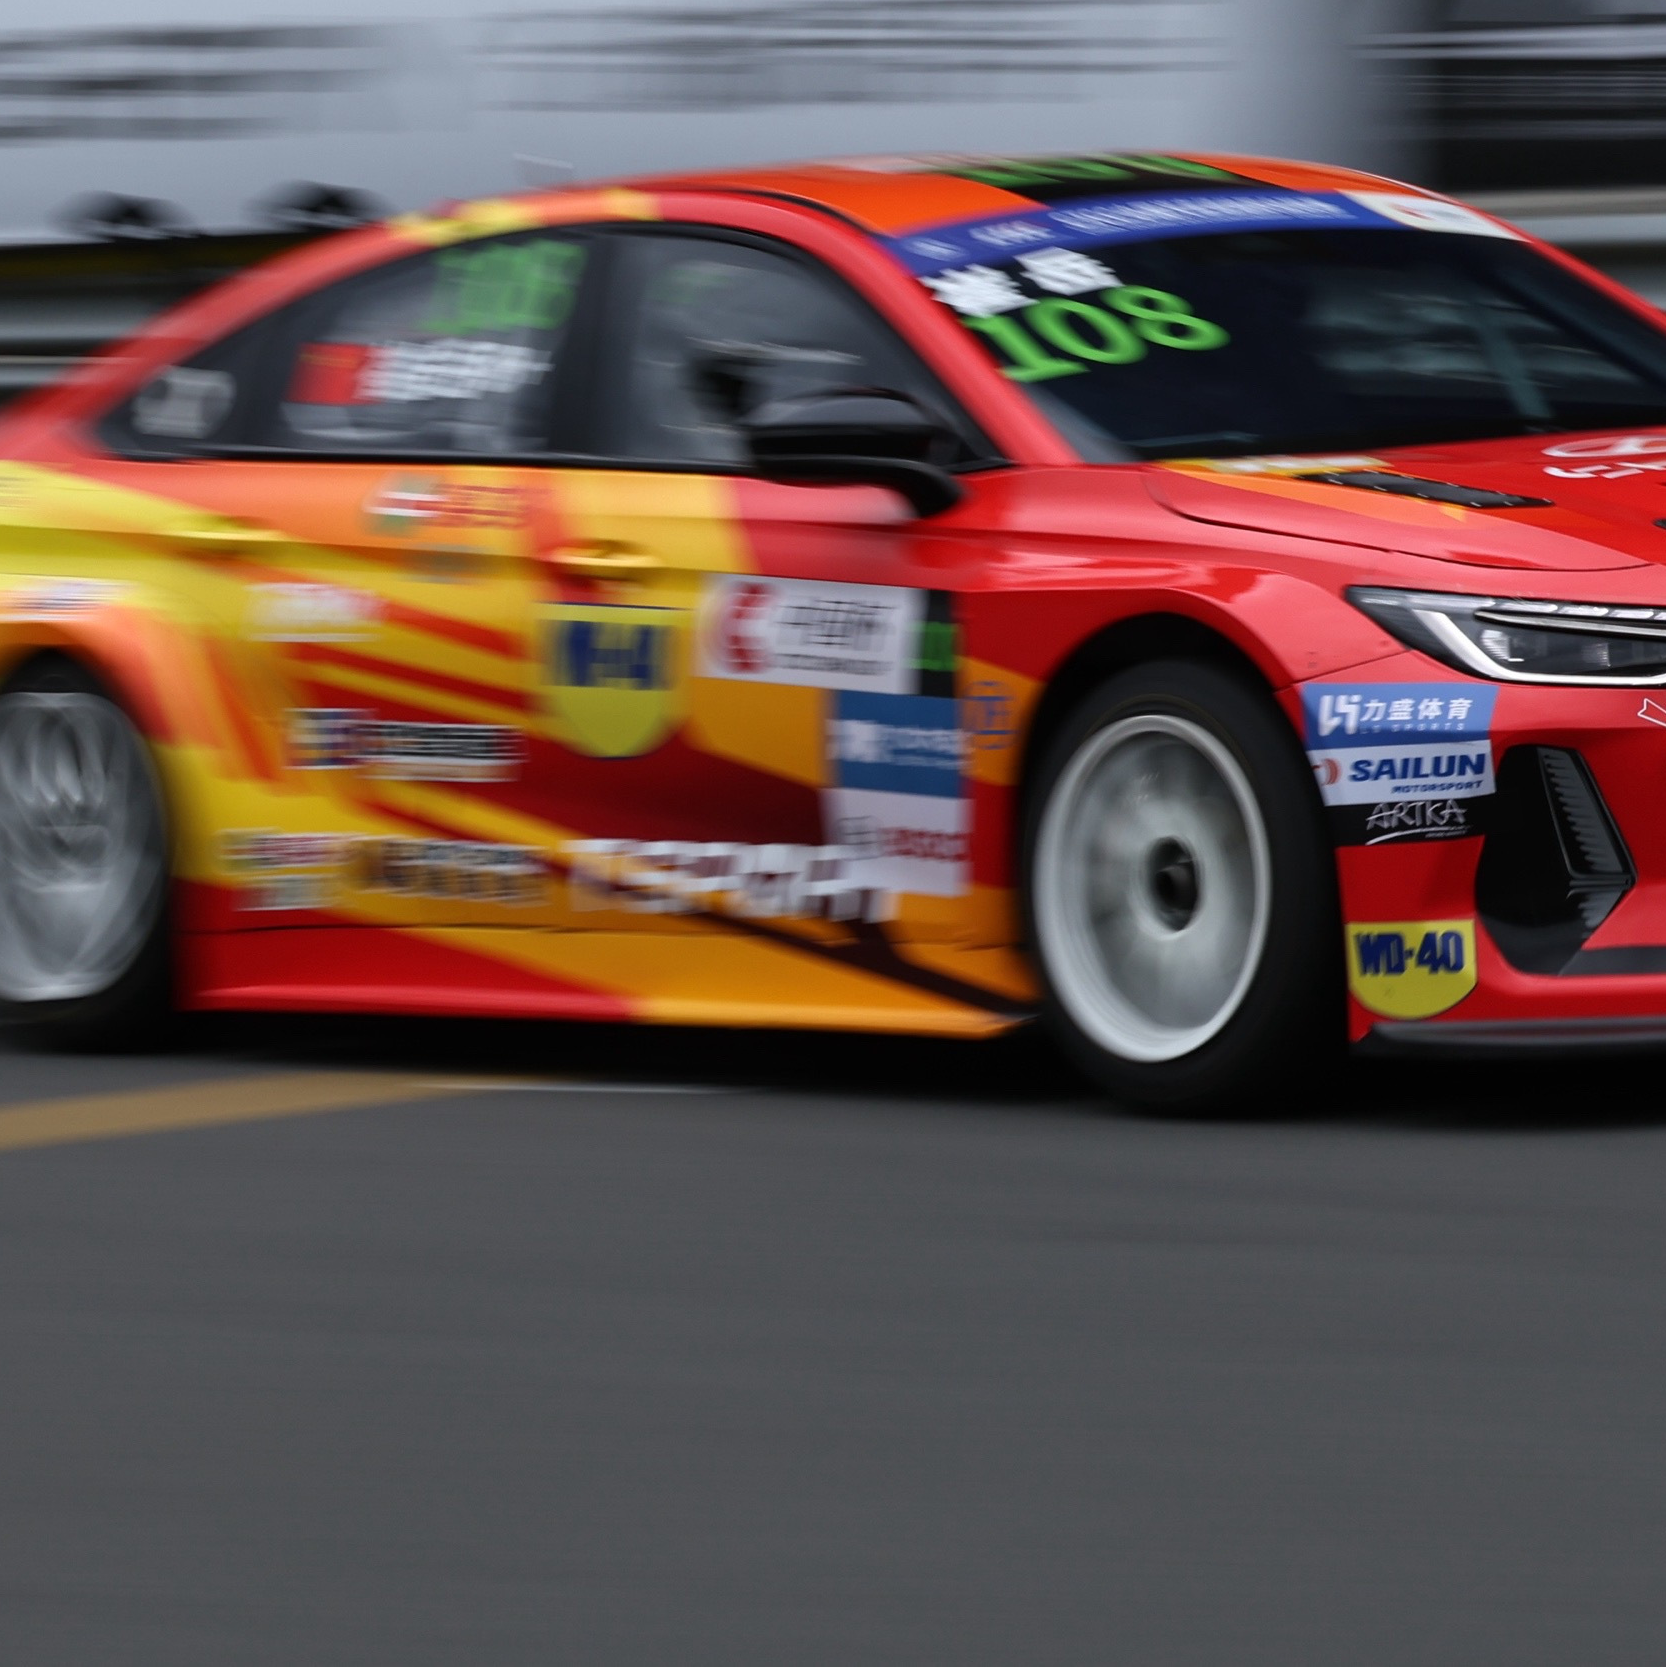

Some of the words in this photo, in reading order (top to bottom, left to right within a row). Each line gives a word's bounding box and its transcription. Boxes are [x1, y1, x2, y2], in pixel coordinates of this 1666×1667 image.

[961, 285, 1230, 382] 108
[1360, 698, 1472, 722] 力盛体育
[1350, 753, 1486, 782] SAILUN
[1392, 780, 1484, 794] MOTORSPORT
[1355, 931, 1465, 976] WD-40
